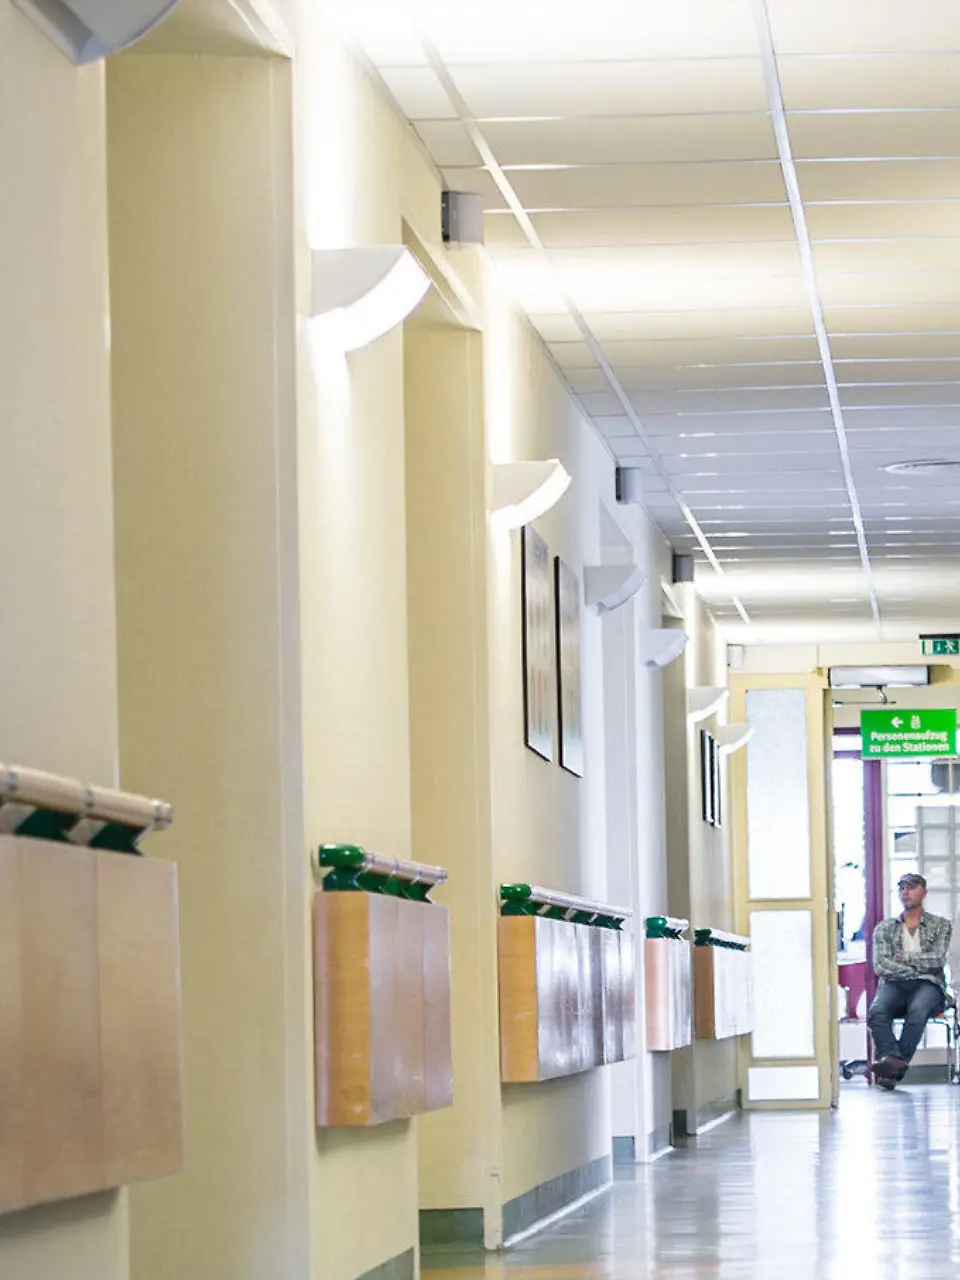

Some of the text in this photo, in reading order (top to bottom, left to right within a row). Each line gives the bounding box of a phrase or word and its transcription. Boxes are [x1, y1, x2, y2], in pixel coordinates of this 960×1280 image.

[871, 730, 947, 741] Personenaufzug
[883, 742, 901, 752] den
[903, 742, 949, 751] Stationen
